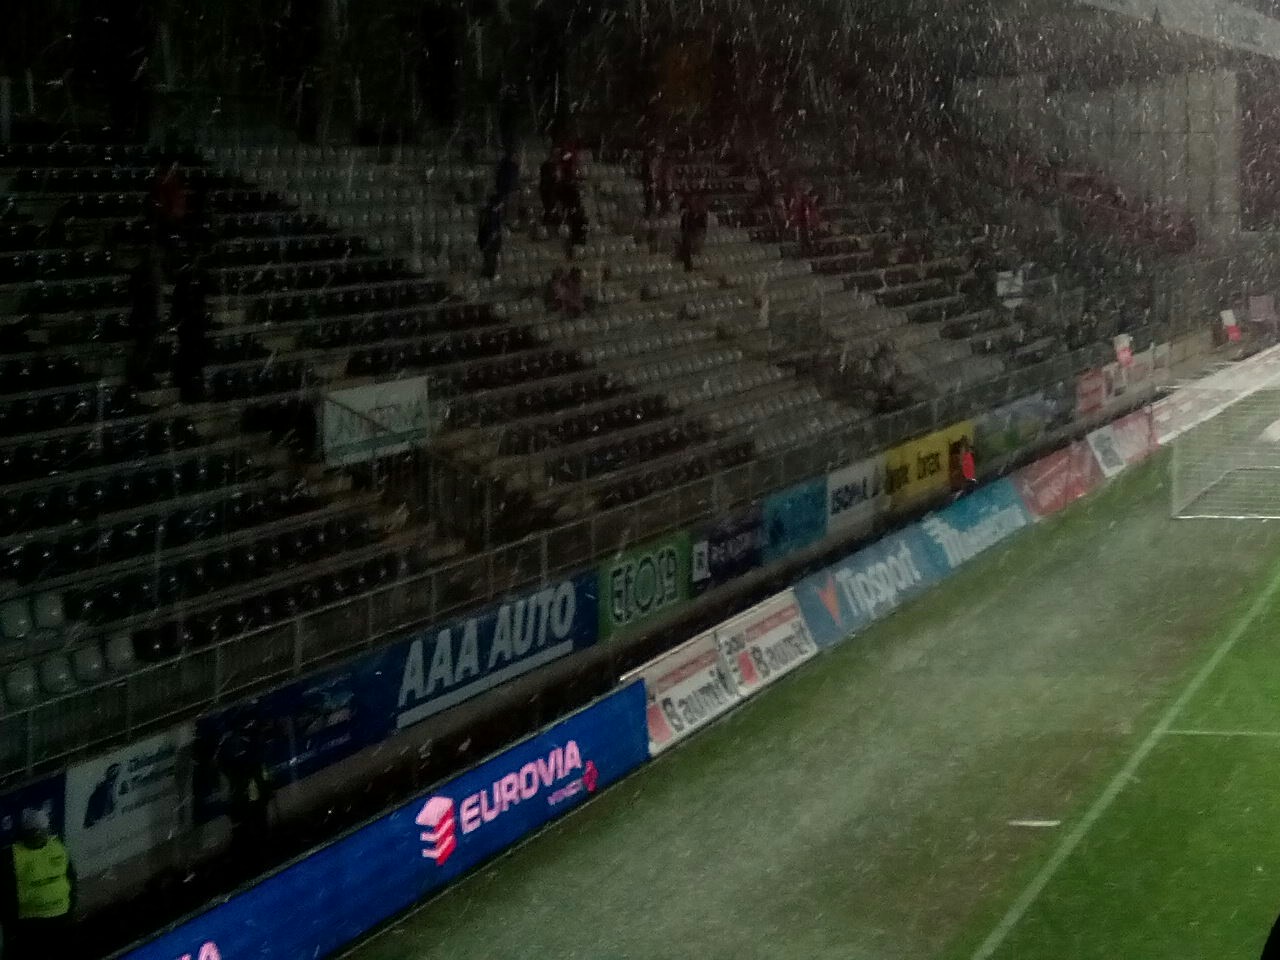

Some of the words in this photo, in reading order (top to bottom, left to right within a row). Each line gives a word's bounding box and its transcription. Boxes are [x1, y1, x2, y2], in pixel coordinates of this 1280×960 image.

[836, 539, 923, 621] Tipsport
[398, 619, 480, 707] AAA
[488, 581, 577, 669] AUTO
[460, 740, 581, 835] EUROVIA
